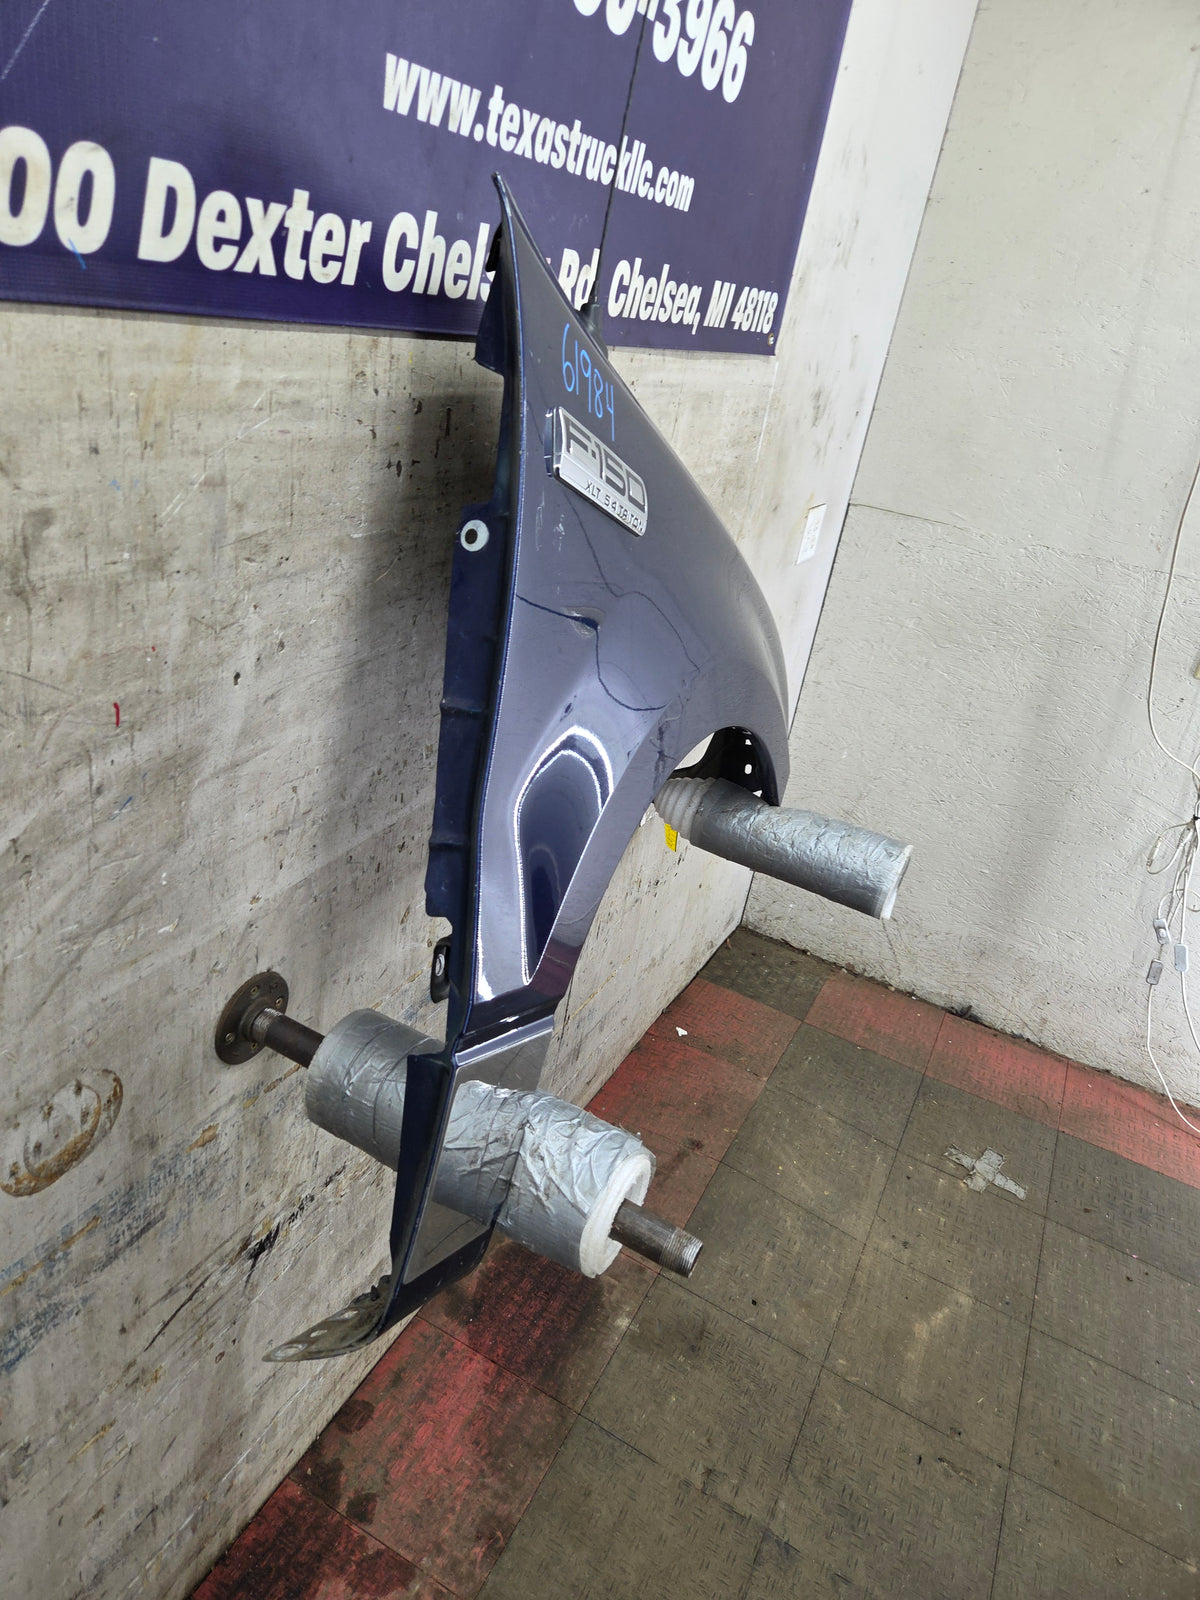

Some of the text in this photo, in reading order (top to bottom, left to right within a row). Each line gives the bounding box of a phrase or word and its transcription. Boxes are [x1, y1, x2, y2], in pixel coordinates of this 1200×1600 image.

[383, 53, 695, 212] www.texastruckllc.com
[138, 156, 372, 286] Dexter
[382, 210, 551, 302] Chel
[607, 257, 702, 335] Chelsea,
[703, 280, 737, 328] MI
[731, 286, 779, 334] 48118
[562, 323, 615, 441] 61984
[585, 480, 601, 499] XLT
